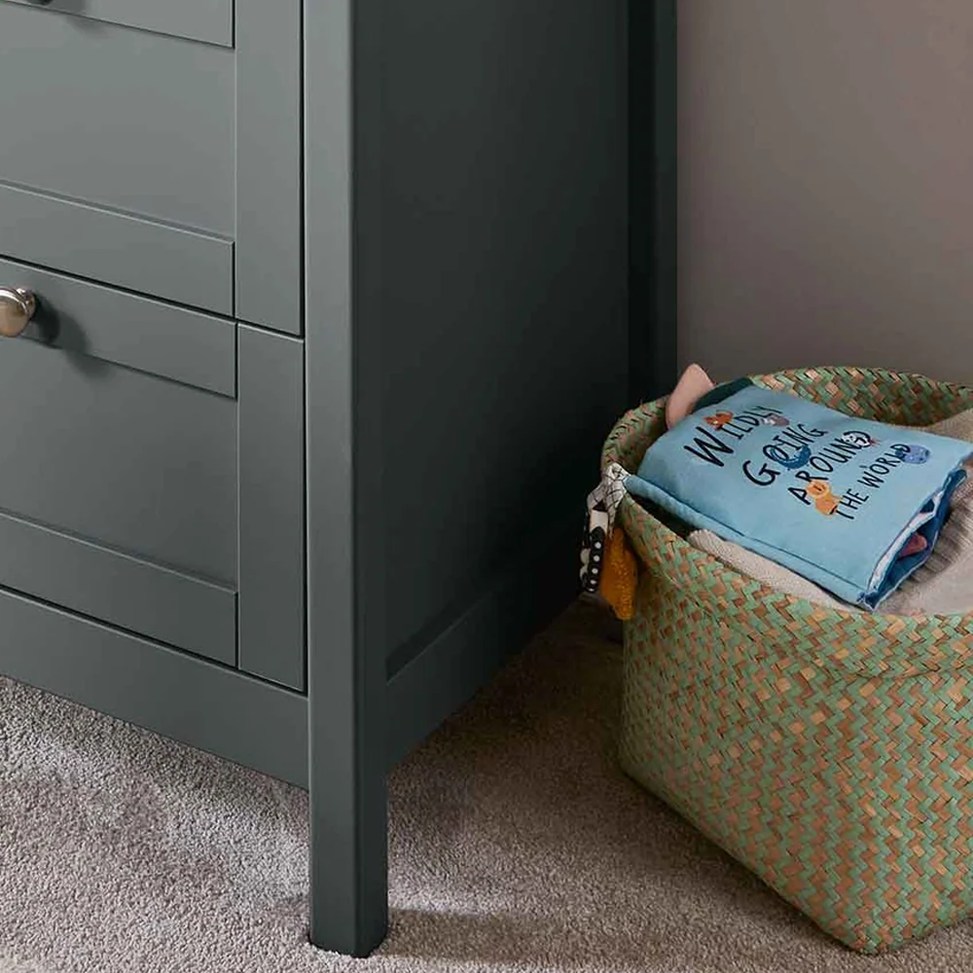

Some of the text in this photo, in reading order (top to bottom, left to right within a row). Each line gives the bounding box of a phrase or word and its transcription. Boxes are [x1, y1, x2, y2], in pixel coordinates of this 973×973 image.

[684, 406, 783, 467] WILDLY
[742, 424, 828, 487] GOING
[788, 430, 872, 506] AROUND
[829, 443, 911, 520] THE WORLD
